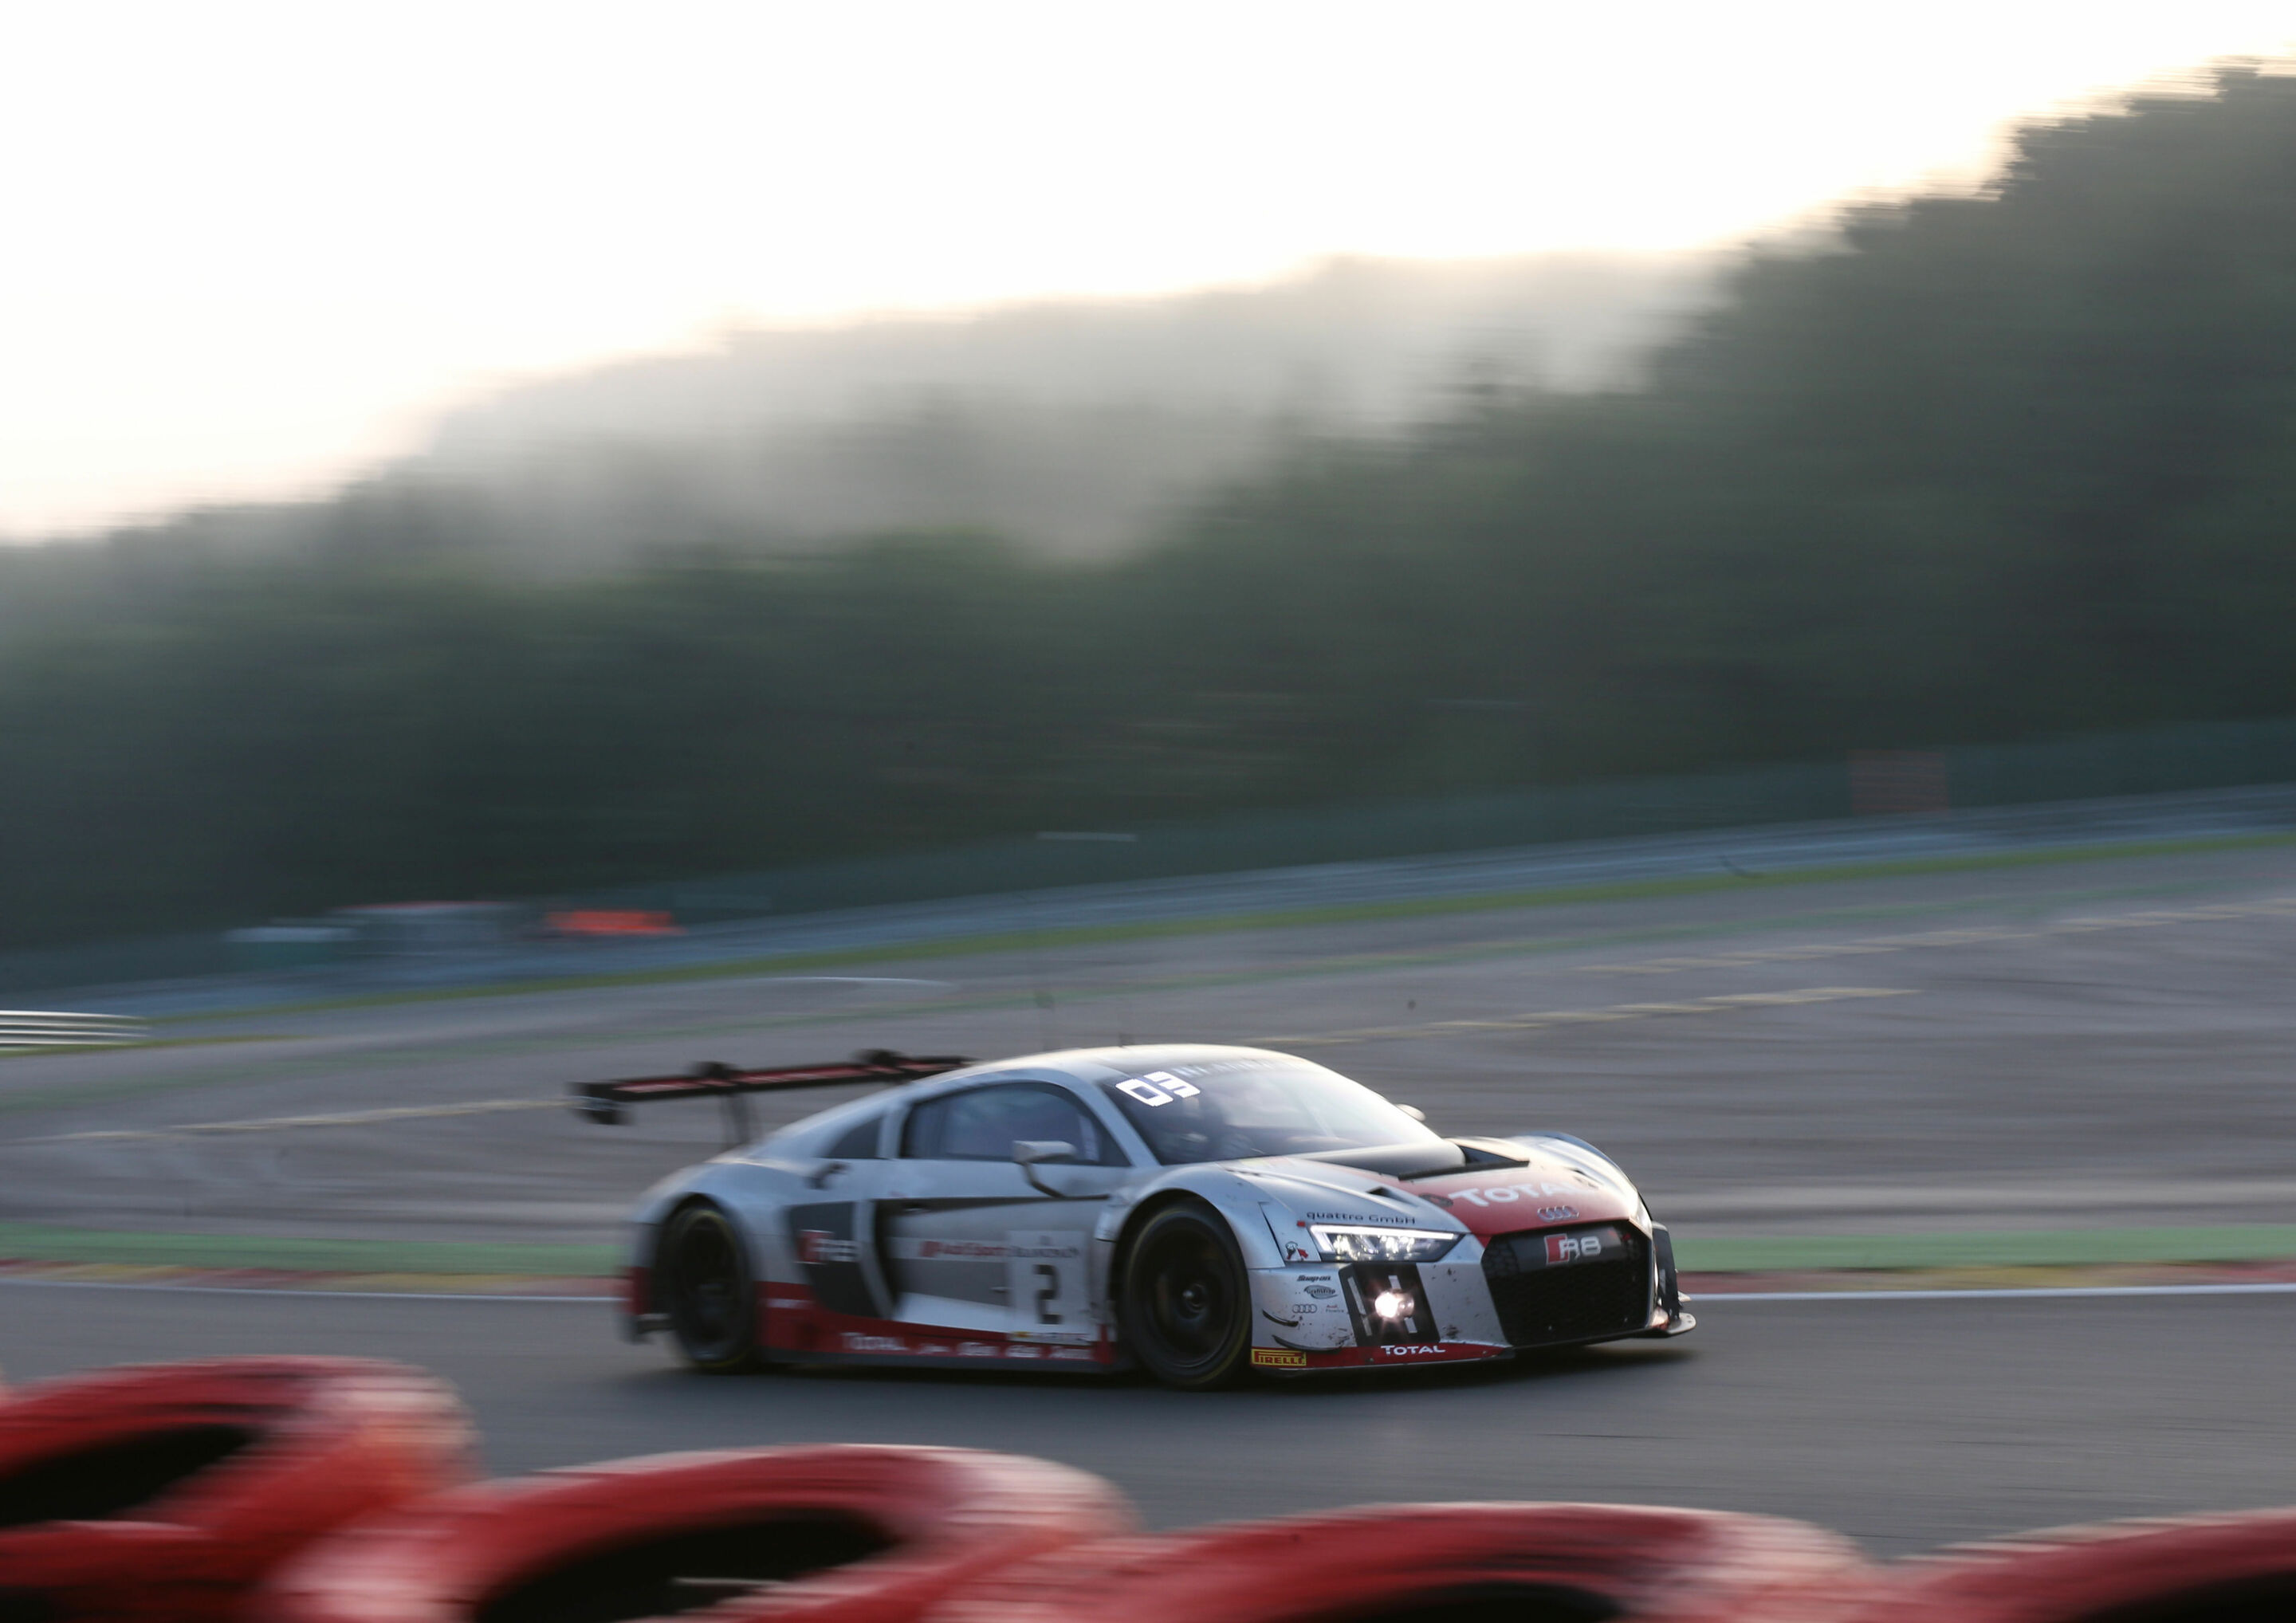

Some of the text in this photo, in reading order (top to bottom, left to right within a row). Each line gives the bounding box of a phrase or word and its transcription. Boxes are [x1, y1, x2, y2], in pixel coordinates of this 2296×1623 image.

[1115, 1071, 1201, 1107] 03
[1307, 1212, 1415, 1224] quattro GmbH
[1556, 1235, 1602, 1260] R8
[1032, 1263, 1063, 1325] 2
[1255, 1351, 1304, 1365] PIRELLI
[1381, 1346, 1446, 1355] TOTAL
